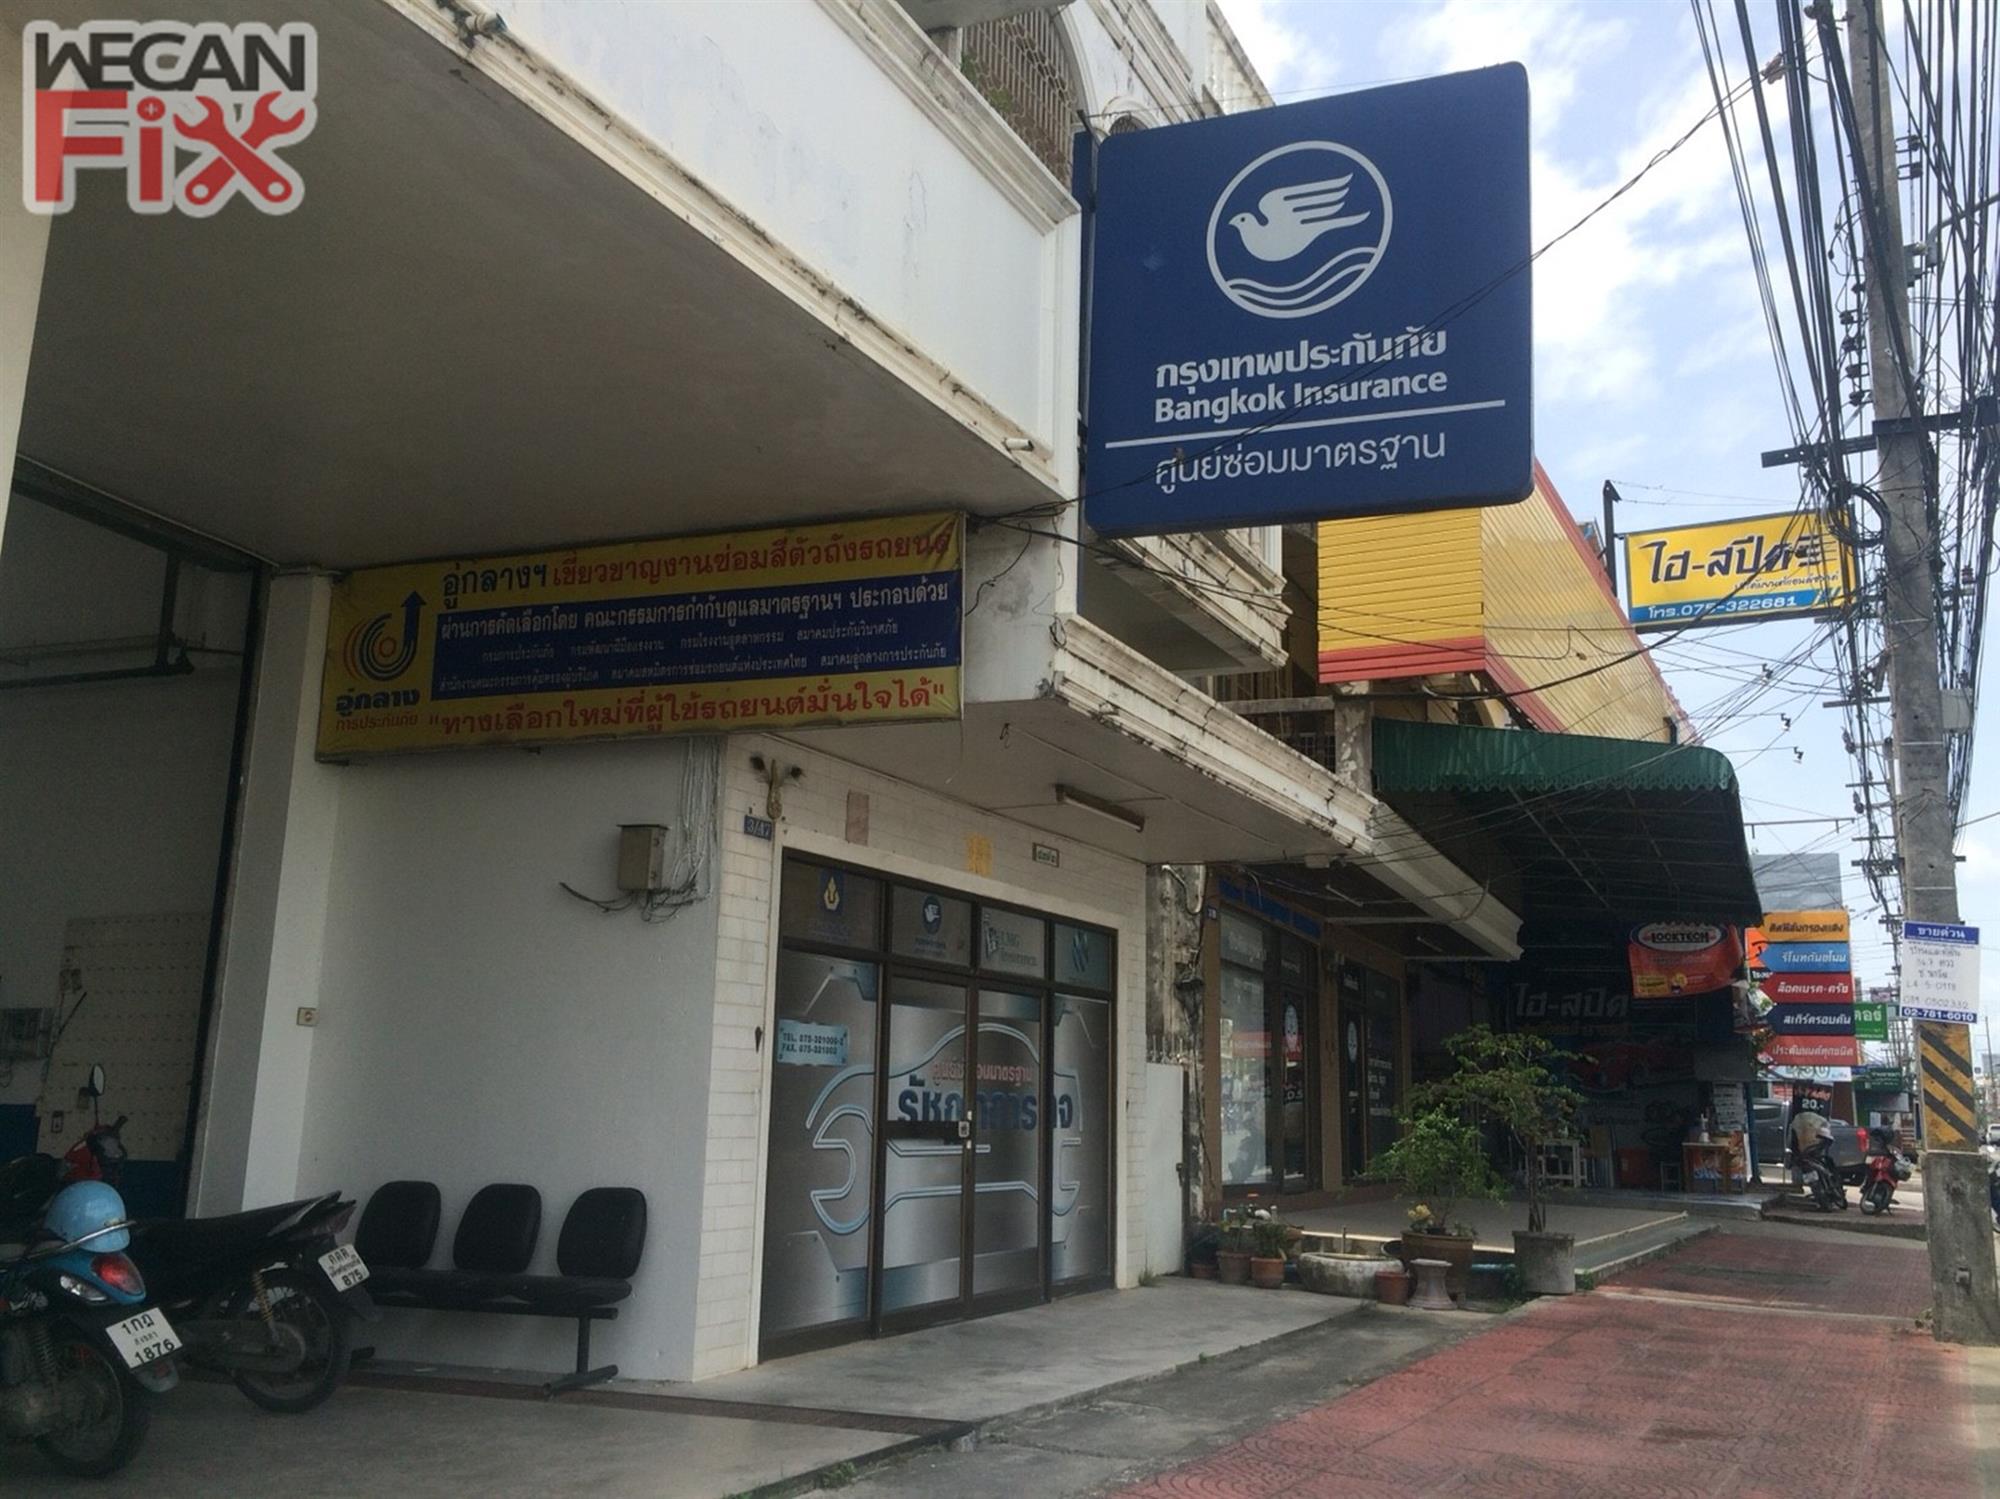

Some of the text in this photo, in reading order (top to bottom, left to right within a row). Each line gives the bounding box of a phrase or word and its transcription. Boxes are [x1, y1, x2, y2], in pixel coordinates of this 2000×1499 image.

[1155, 325, 1447, 395] กรุงเทพประกันภัย
[1155, 369, 1448, 423] Bangkok Insurance
[1155, 432, 1446, 494] ศูนย์ซ่อมมาตรฐาน
[443, 562, 547, 610] อู่กลางฯ
[441, 606, 577, 640] ผ่านการคัดเลือกโดย
[850, 578, 948, 607] ประกอบด้วย
[797, 617, 898, 642] สมาคมประกันวินาศภัย
[336, 687, 420, 717] อู่กลาง
[1917, 926, 1966, 938] ขายด่วน
[1903, 1007, 1974, 1021] 02-781-6010
[341, 1269, 364, 1287] 875
[135, 1338, 176, 1365] 1876
